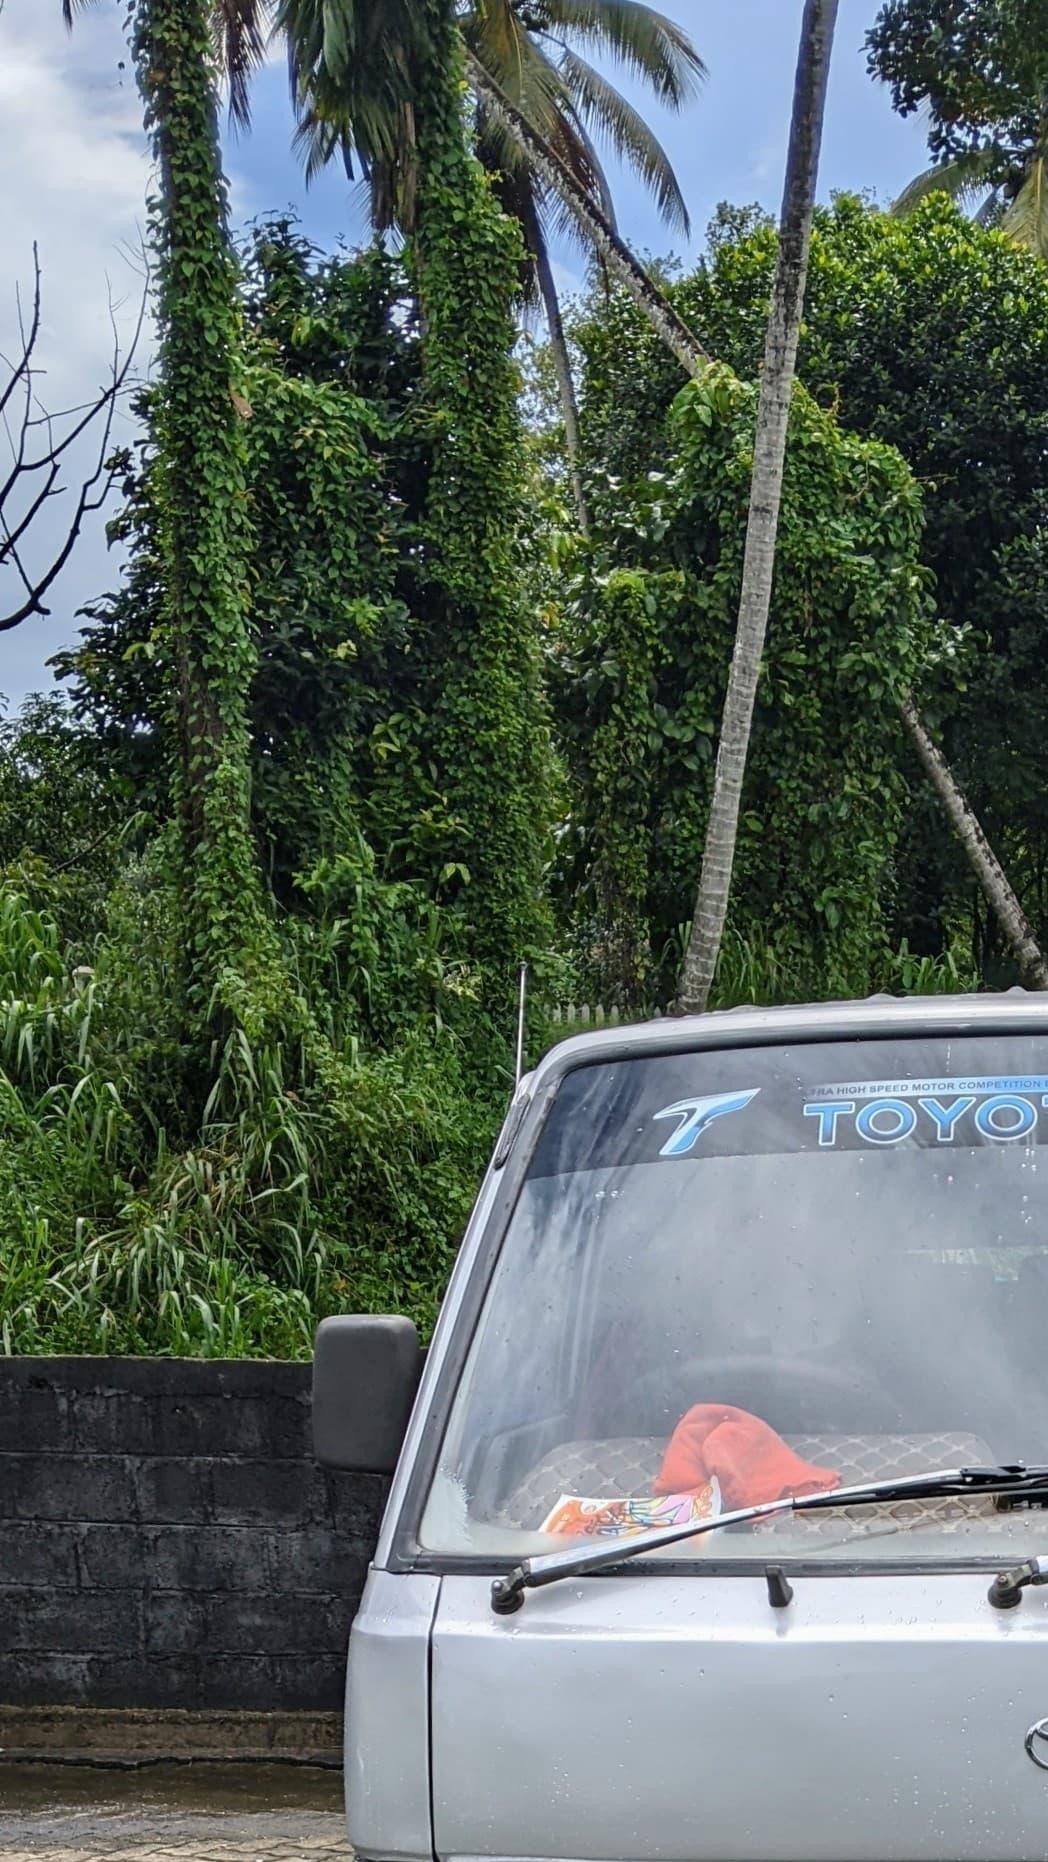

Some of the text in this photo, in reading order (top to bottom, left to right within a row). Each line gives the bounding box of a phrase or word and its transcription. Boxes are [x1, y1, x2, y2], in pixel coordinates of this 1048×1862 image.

[836, 1085, 866, 1096] HIGH
[869, 1083, 909, 1094] SPEED
[911, 1081, 955, 1092] MOTOR
[958, 1079, 1041, 1091] COMPETITION
